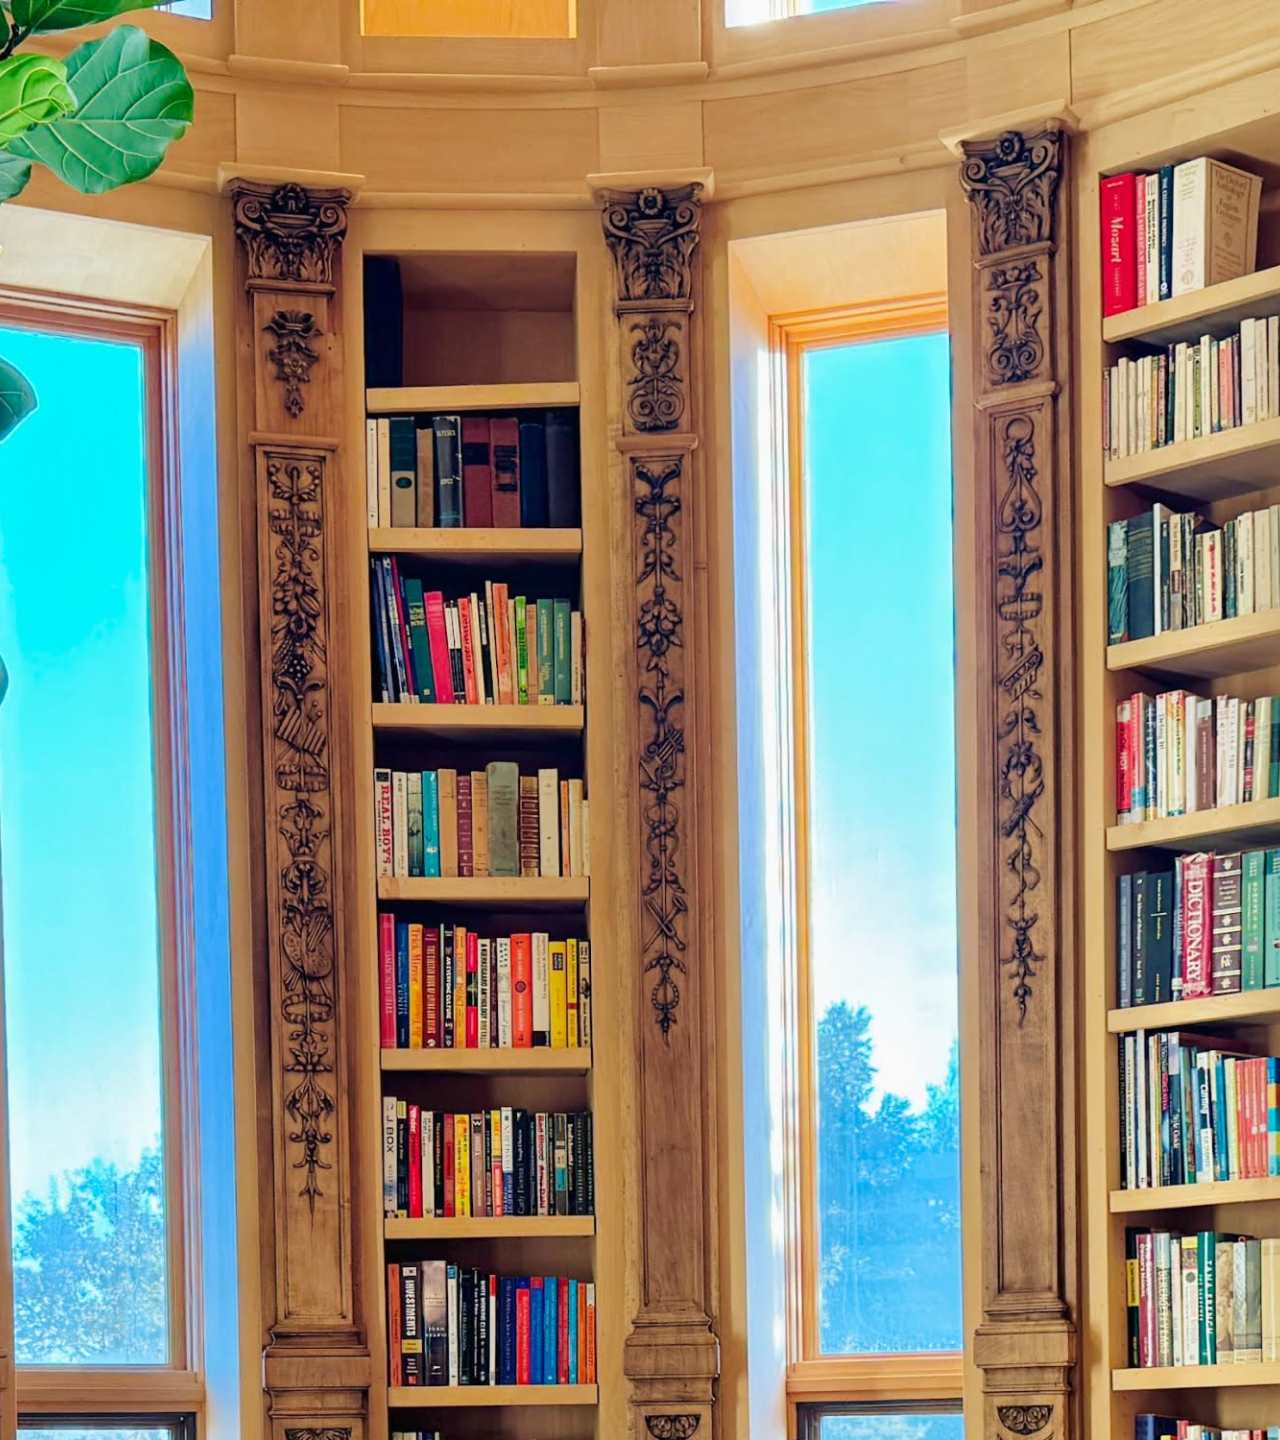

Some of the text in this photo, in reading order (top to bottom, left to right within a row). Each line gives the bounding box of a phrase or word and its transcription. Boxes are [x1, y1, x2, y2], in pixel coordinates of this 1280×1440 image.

[1110, 217, 1124, 263] Mozart
[382, 784, 392, 864] REAL BOYS
[1186, 880, 1204, 981] DICTIONARY
[386, 1127, 394, 1152] BOX
[404, 1280, 416, 1336] INVESTMENTS
